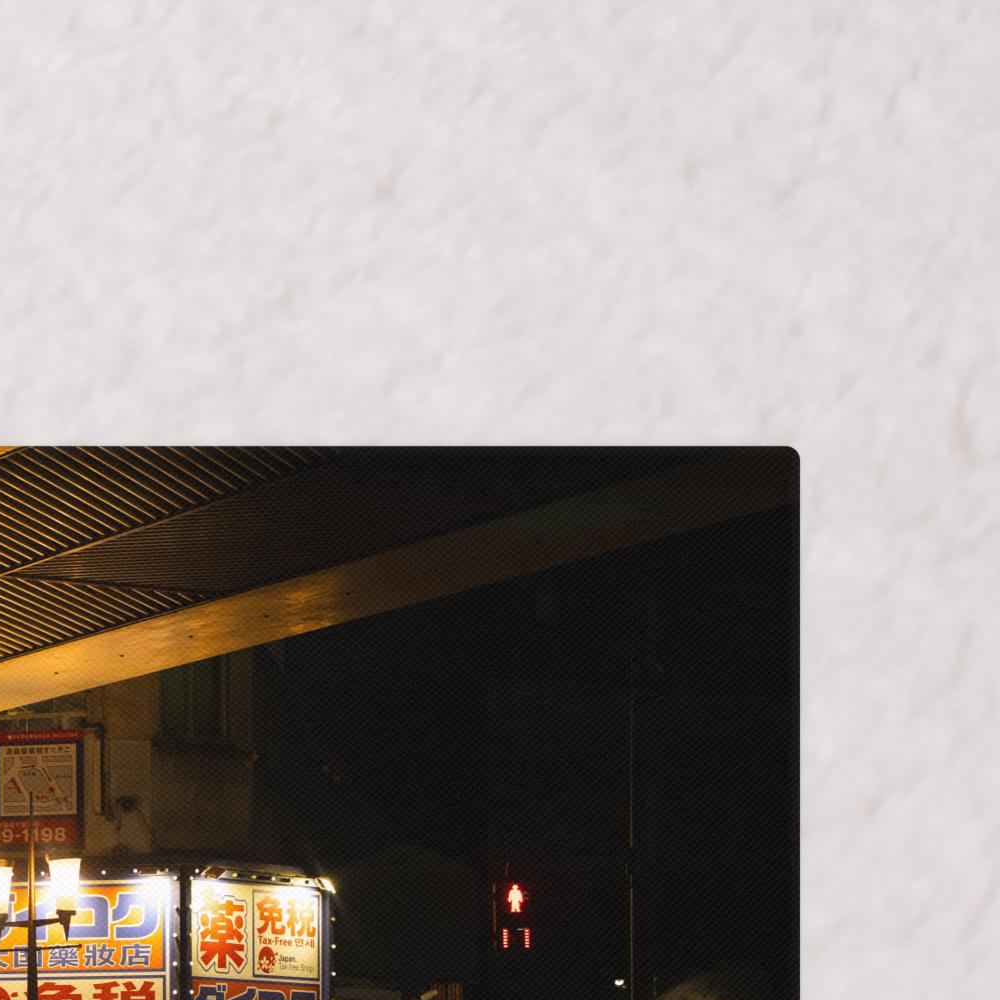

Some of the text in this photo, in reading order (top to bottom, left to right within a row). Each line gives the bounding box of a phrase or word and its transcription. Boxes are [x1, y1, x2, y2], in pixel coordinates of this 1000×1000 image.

[200, 898, 245, 969] 薬
[256, 895, 316, 937] 免税
[258, 935, 293, 947] Tax-Free
